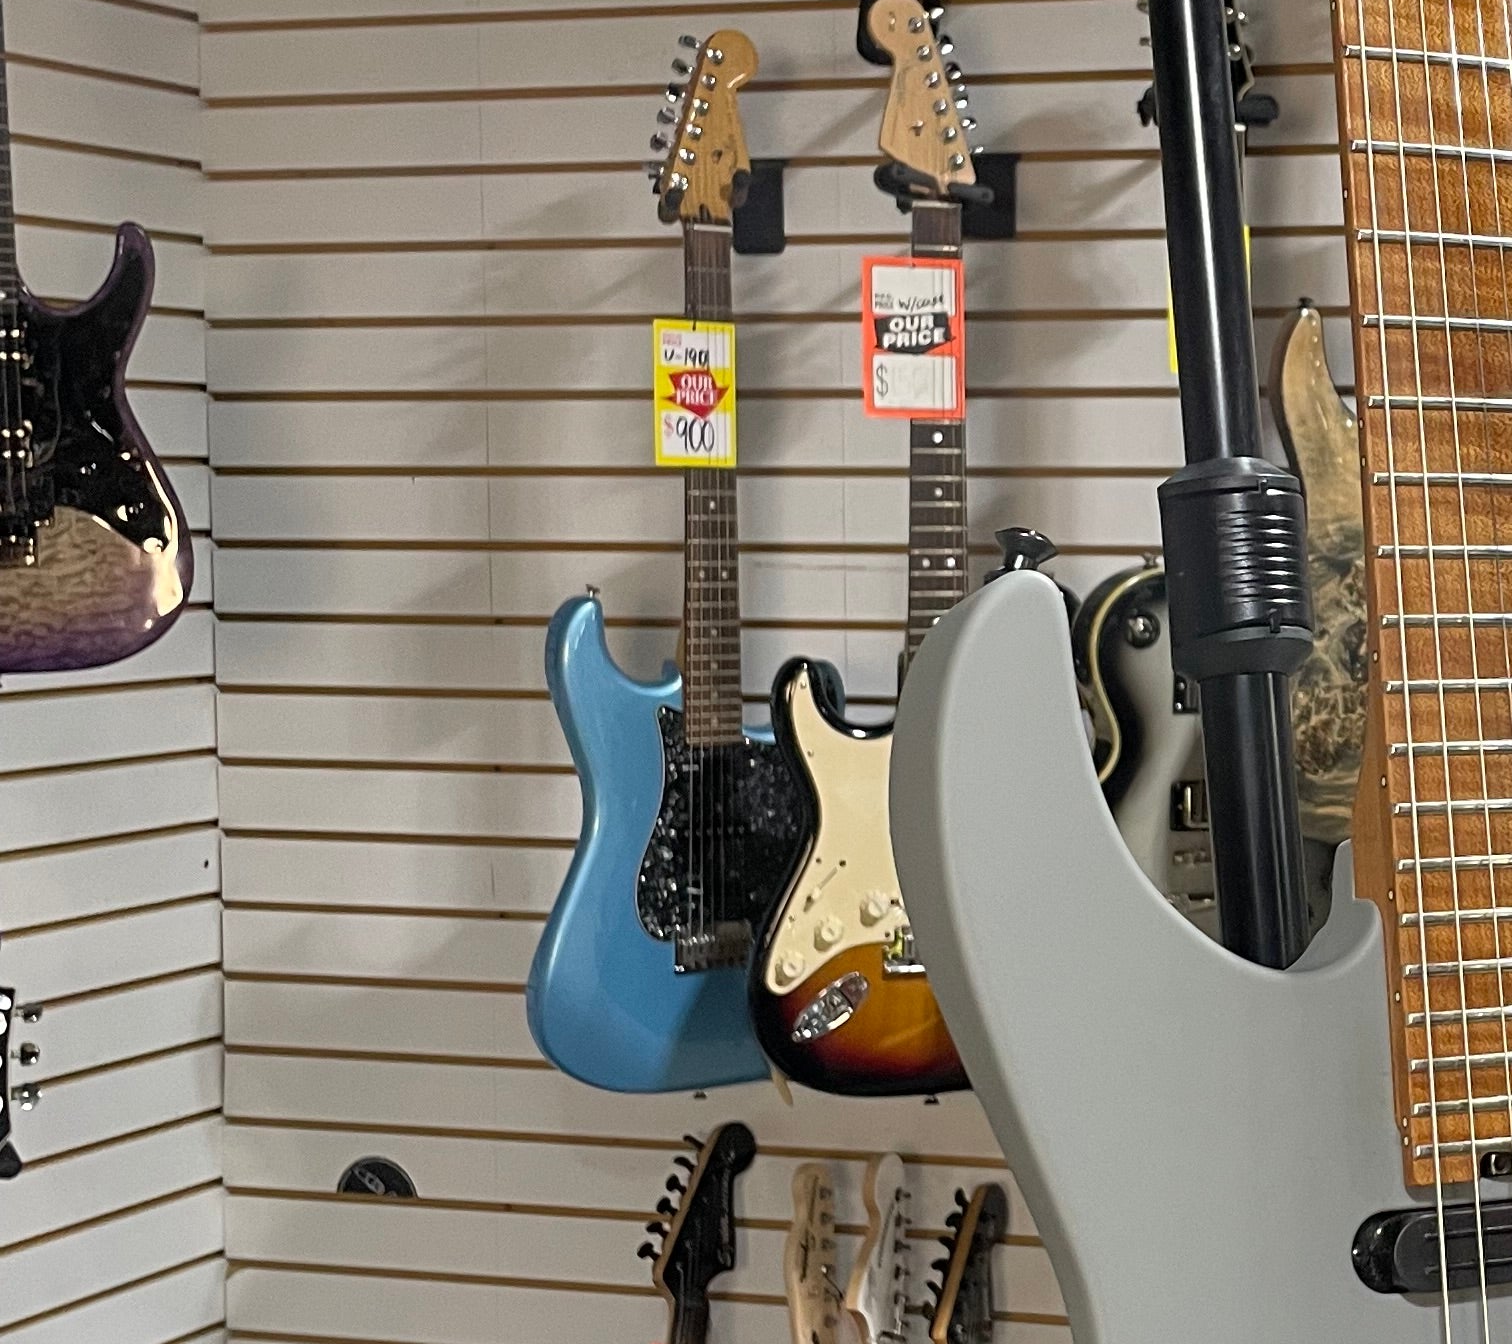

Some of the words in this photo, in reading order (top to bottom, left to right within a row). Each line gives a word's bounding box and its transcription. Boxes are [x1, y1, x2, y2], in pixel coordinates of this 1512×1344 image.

[888, 314, 935, 333] OUR
[882, 327, 946, 349] PRICE
[679, 374, 714, 390] OUR
[676, 389, 717, 407] PRICE
[663, 416, 715, 453] $900
